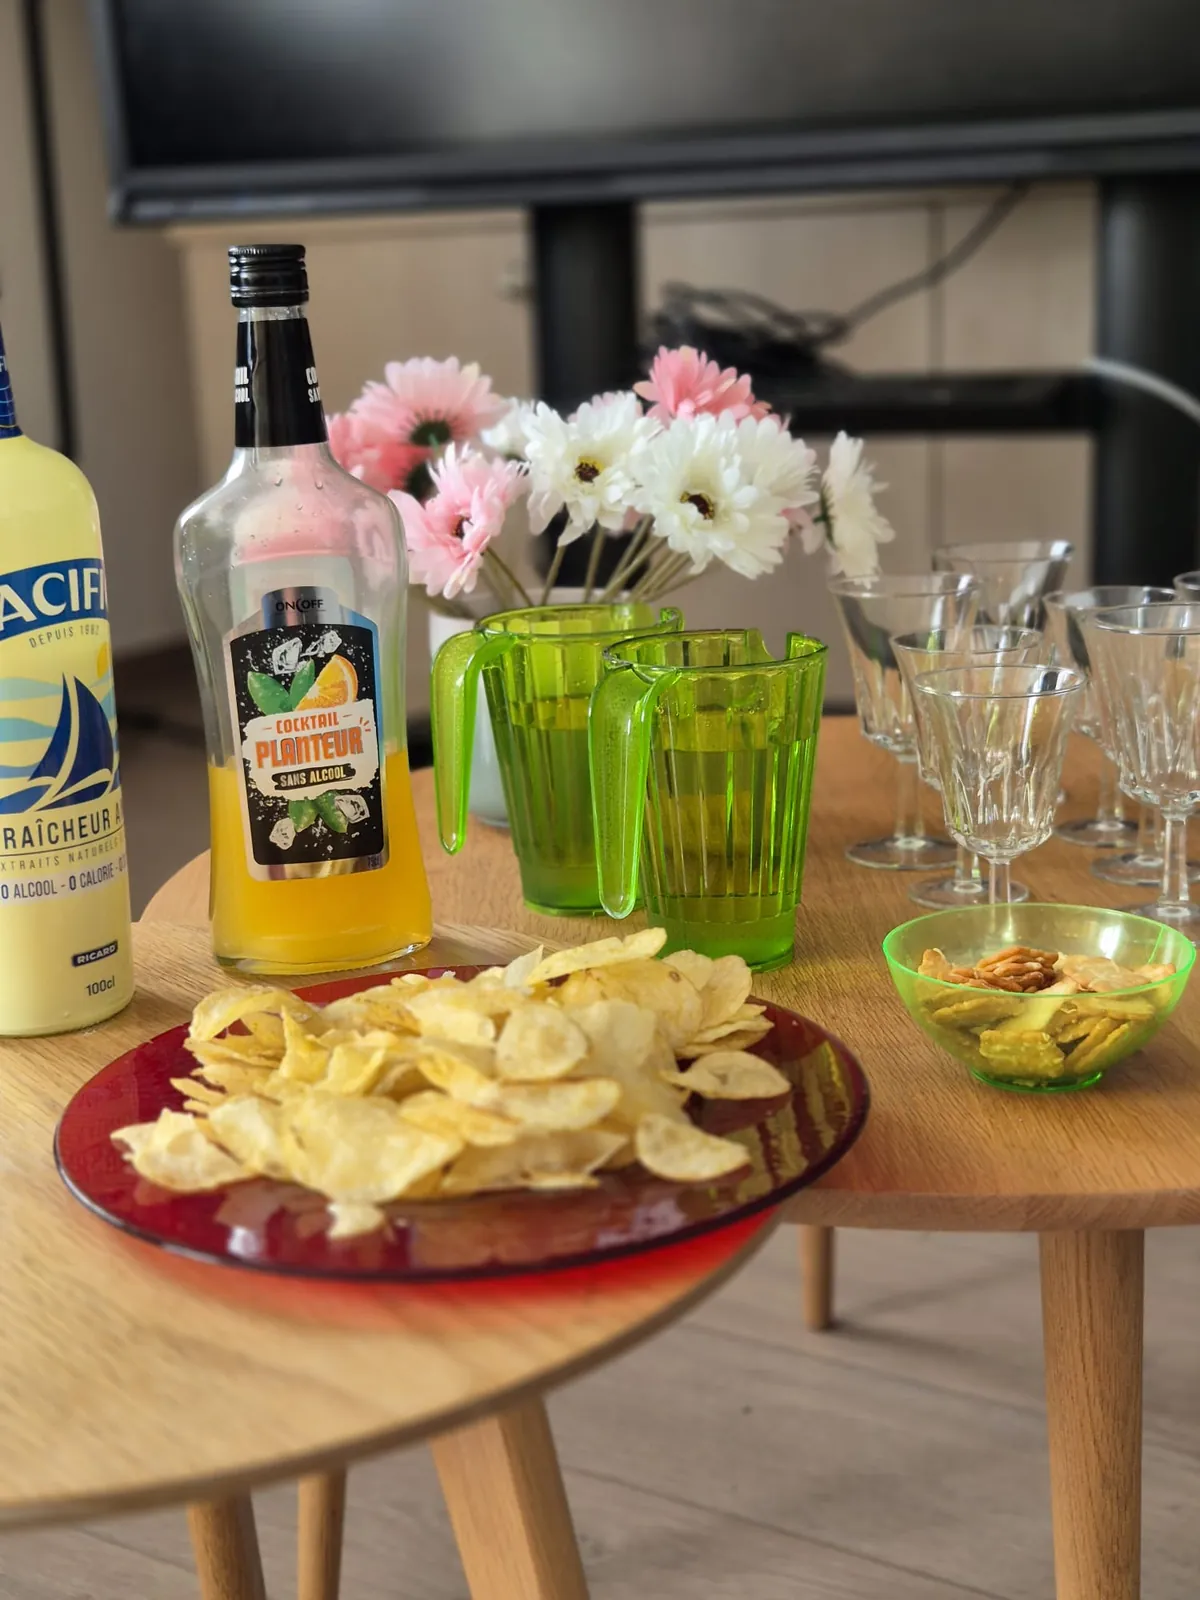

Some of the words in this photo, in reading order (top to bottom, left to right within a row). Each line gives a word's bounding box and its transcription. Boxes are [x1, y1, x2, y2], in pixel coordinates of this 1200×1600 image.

[29, 626, 74, 648] DEPUIS
[276, 712, 339, 734] COCKTAIL
[255, 726, 364, 769] PLANTEUR
[280, 773, 306, 787] SANS
[310, 766, 346, 783] ALCOOL
[3, 808, 110, 849] RAÎCHEUR
[14, 880, 57, 898] ALCOOL
[80, 862, 114, 888] CALORIE
[77, 945, 116, 965] RICARD
[85, 976, 115, 997] 100cl
